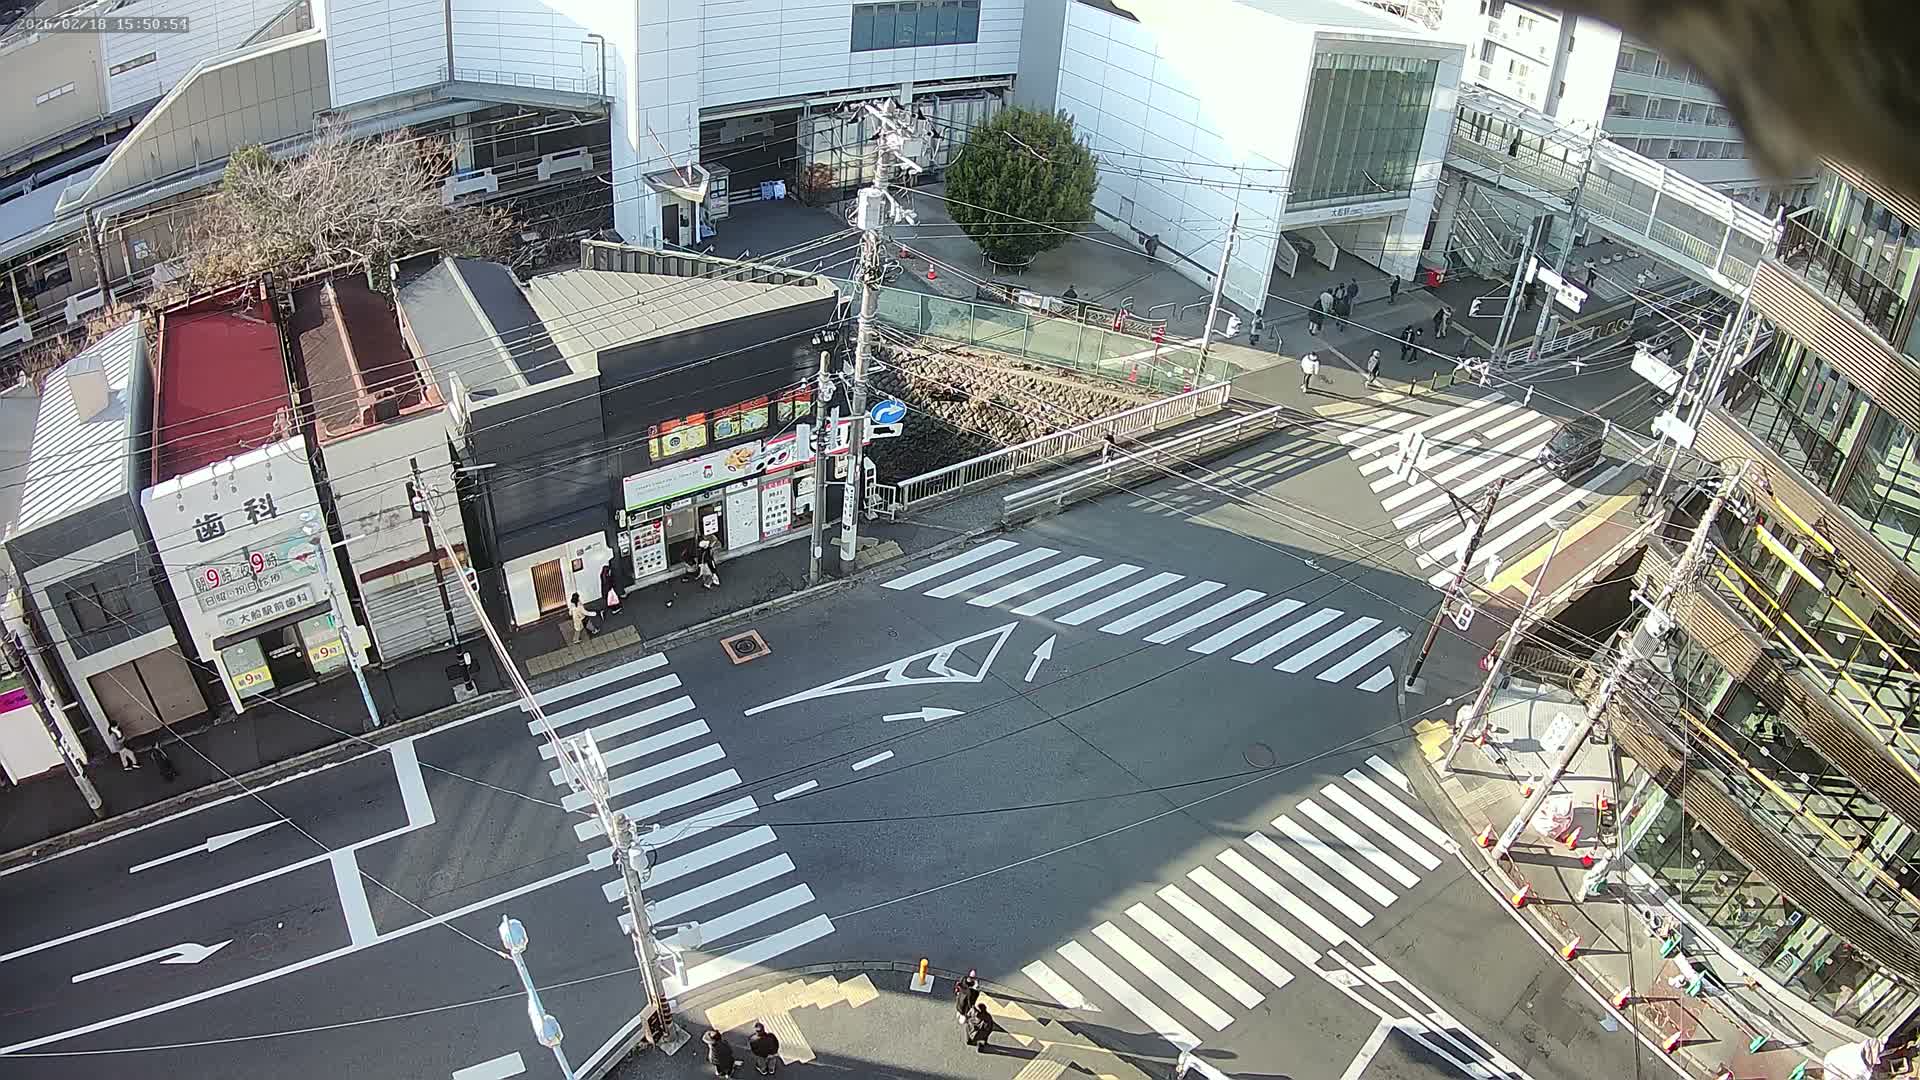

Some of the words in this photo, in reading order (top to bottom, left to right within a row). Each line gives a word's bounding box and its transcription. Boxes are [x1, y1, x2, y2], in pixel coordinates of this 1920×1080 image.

[192, 493, 277, 543] 歯科
[239, 592, 308, 625] 大船駅前歯科
